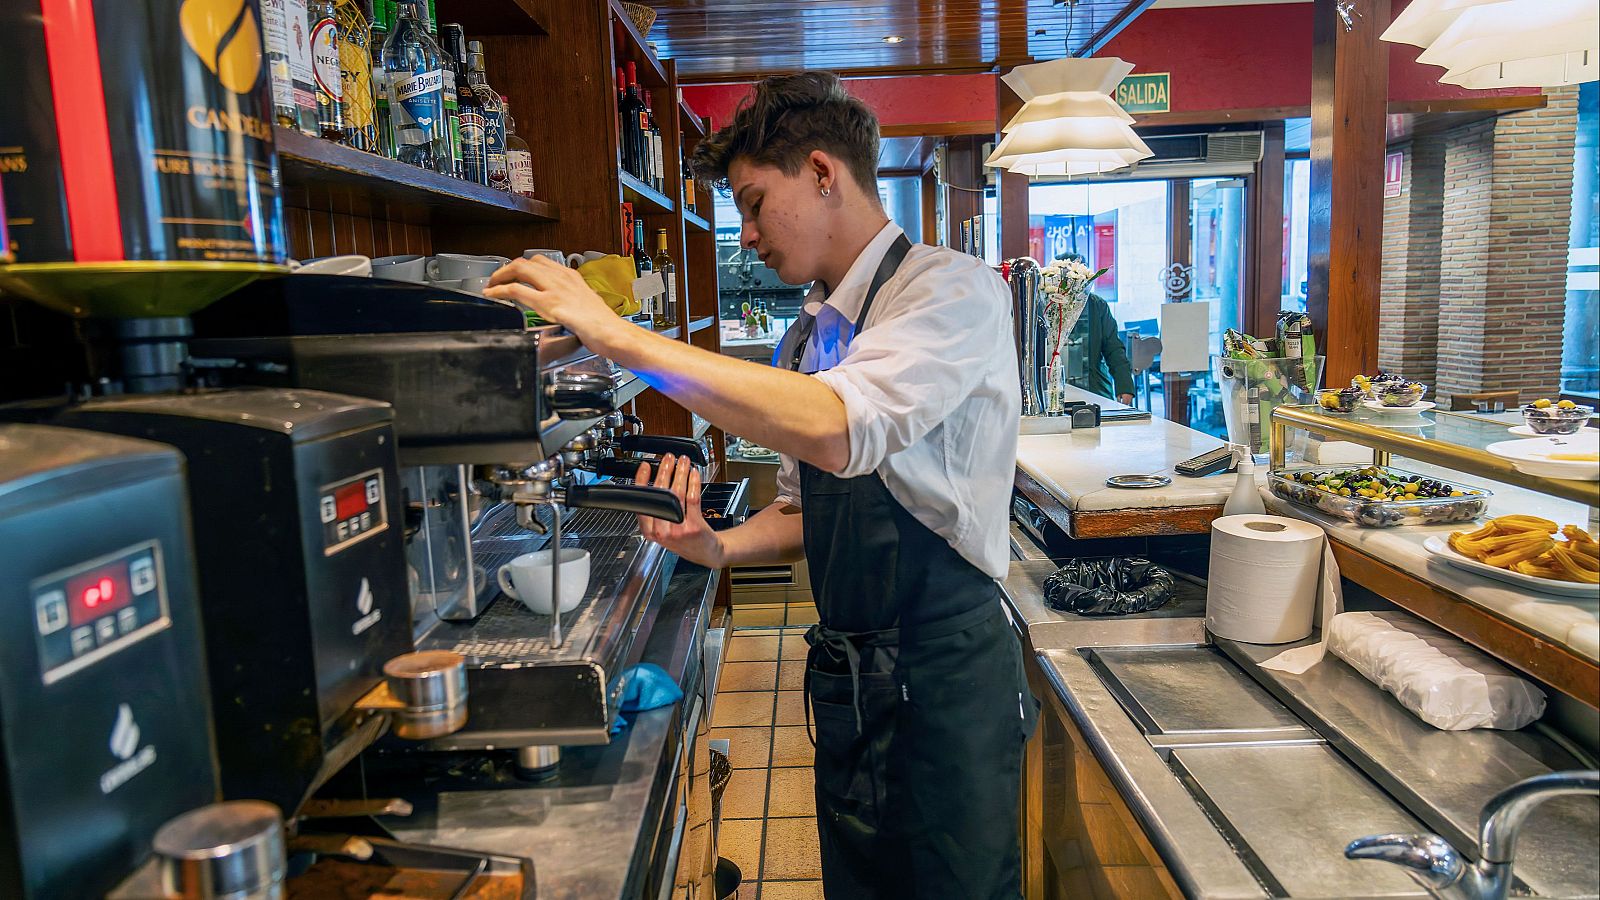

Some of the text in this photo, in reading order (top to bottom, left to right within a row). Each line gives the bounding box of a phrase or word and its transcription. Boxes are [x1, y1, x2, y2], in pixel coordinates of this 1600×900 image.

[397, 81, 418, 95] MARIE
[418, 75, 442, 92] BRIZARD
[1119, 82, 1167, 105] SALIDA
